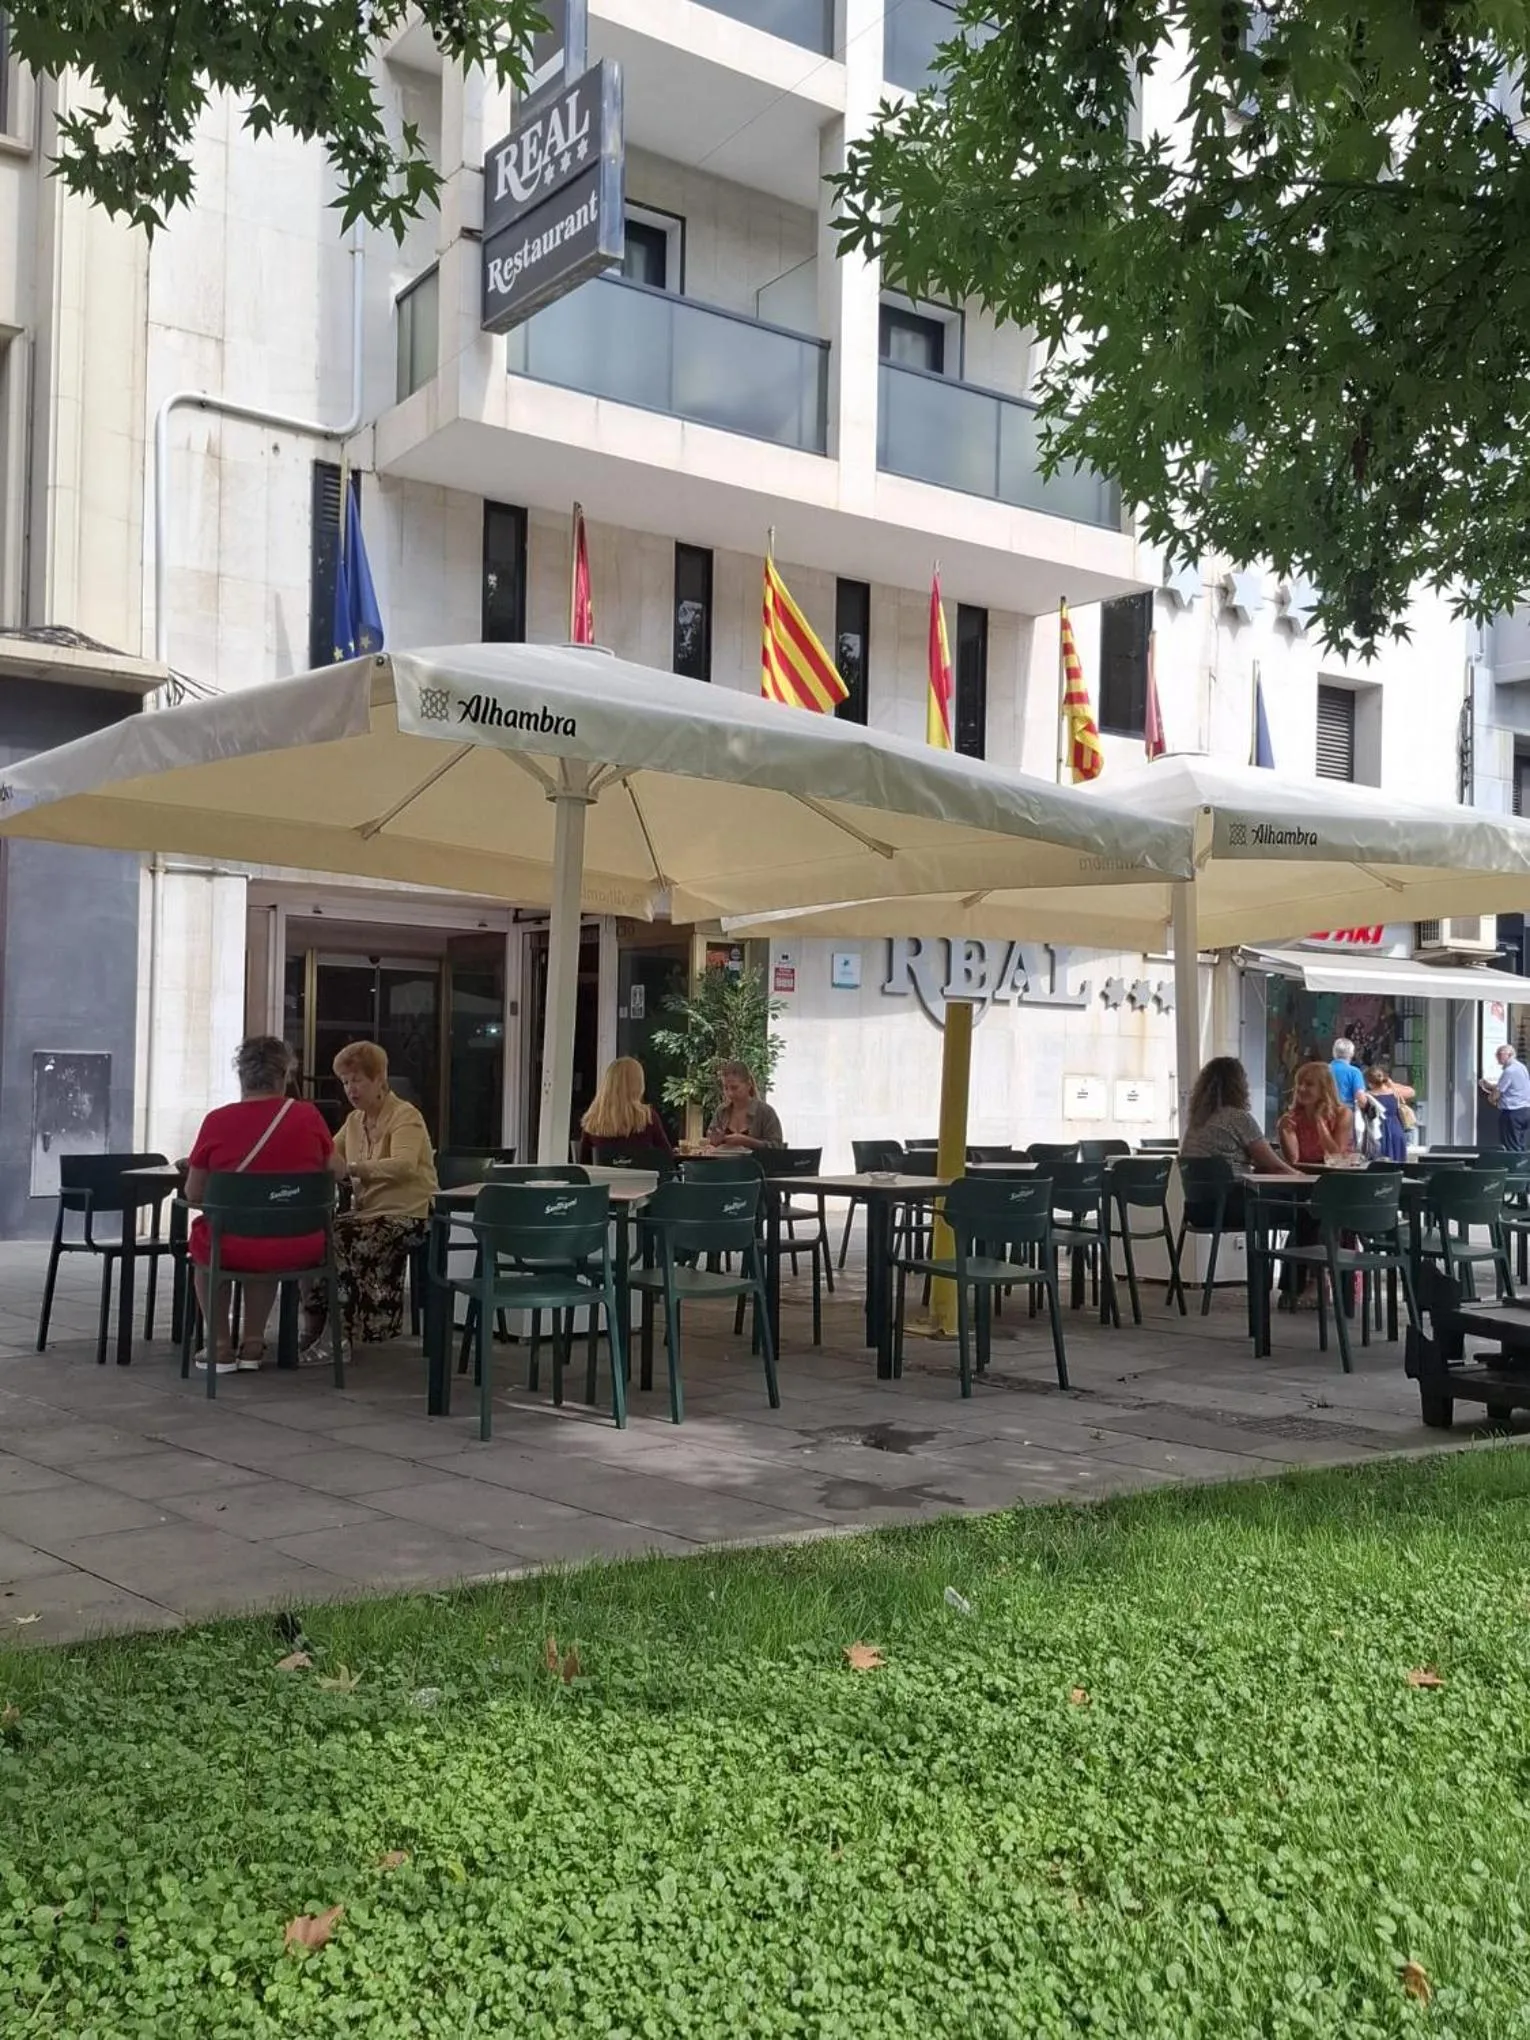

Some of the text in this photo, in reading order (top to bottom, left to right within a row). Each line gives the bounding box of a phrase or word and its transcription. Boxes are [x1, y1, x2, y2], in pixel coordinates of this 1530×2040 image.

[494, 89, 590, 202] REAL
[487, 189, 599, 294] Restaurant
[457, 694, 577, 737] Alhambra
[1251, 823, 1318, 846] Alhambra
[881, 936, 1092, 1030] REAL
